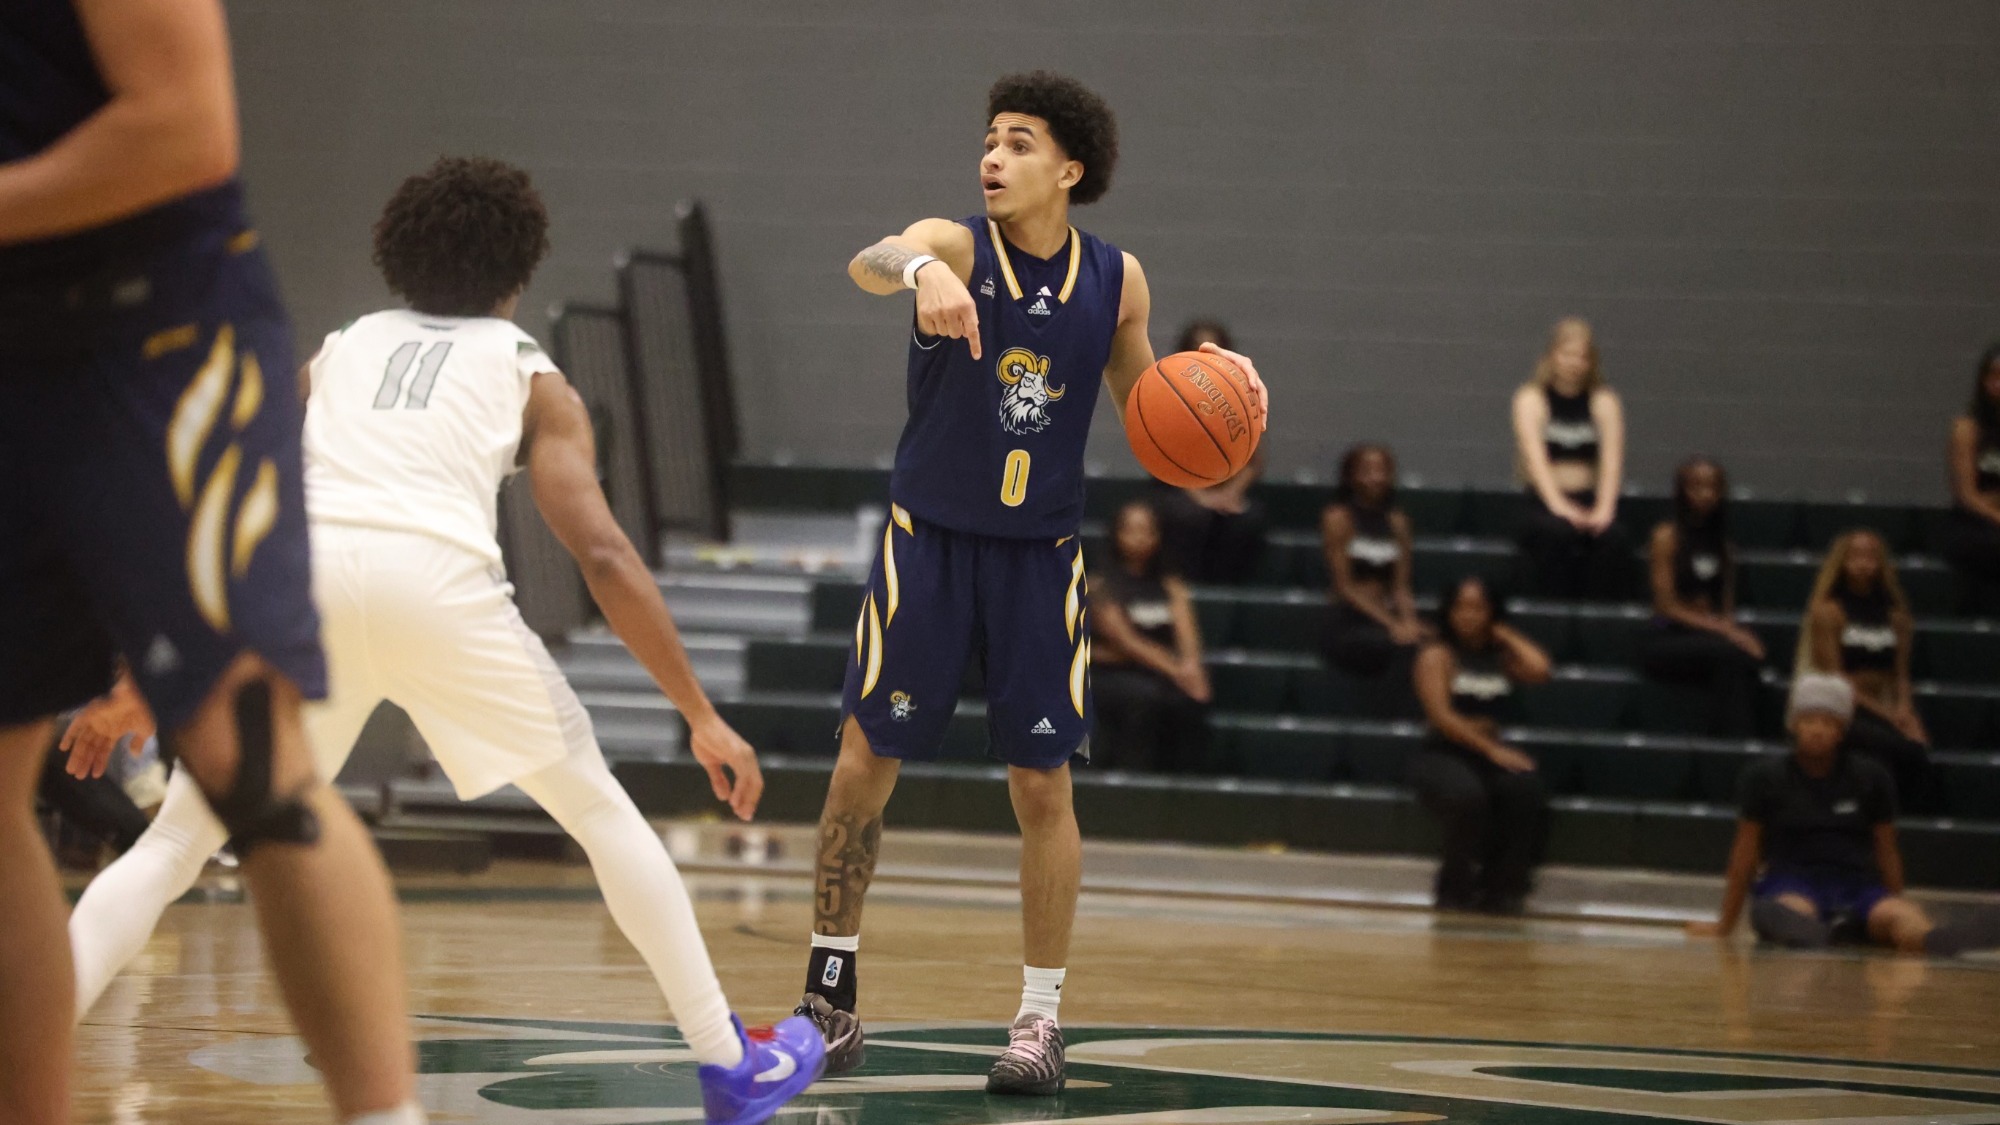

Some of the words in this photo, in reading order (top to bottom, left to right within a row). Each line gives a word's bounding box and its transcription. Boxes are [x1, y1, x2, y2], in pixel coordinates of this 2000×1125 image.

[1027, 307, 1052, 316] adidas
[372, 341, 453, 410] 11
[1180, 364, 1246, 442] SPALDING
[1001, 449, 1031, 507] 0
[1030, 727, 1057, 735] adidas
